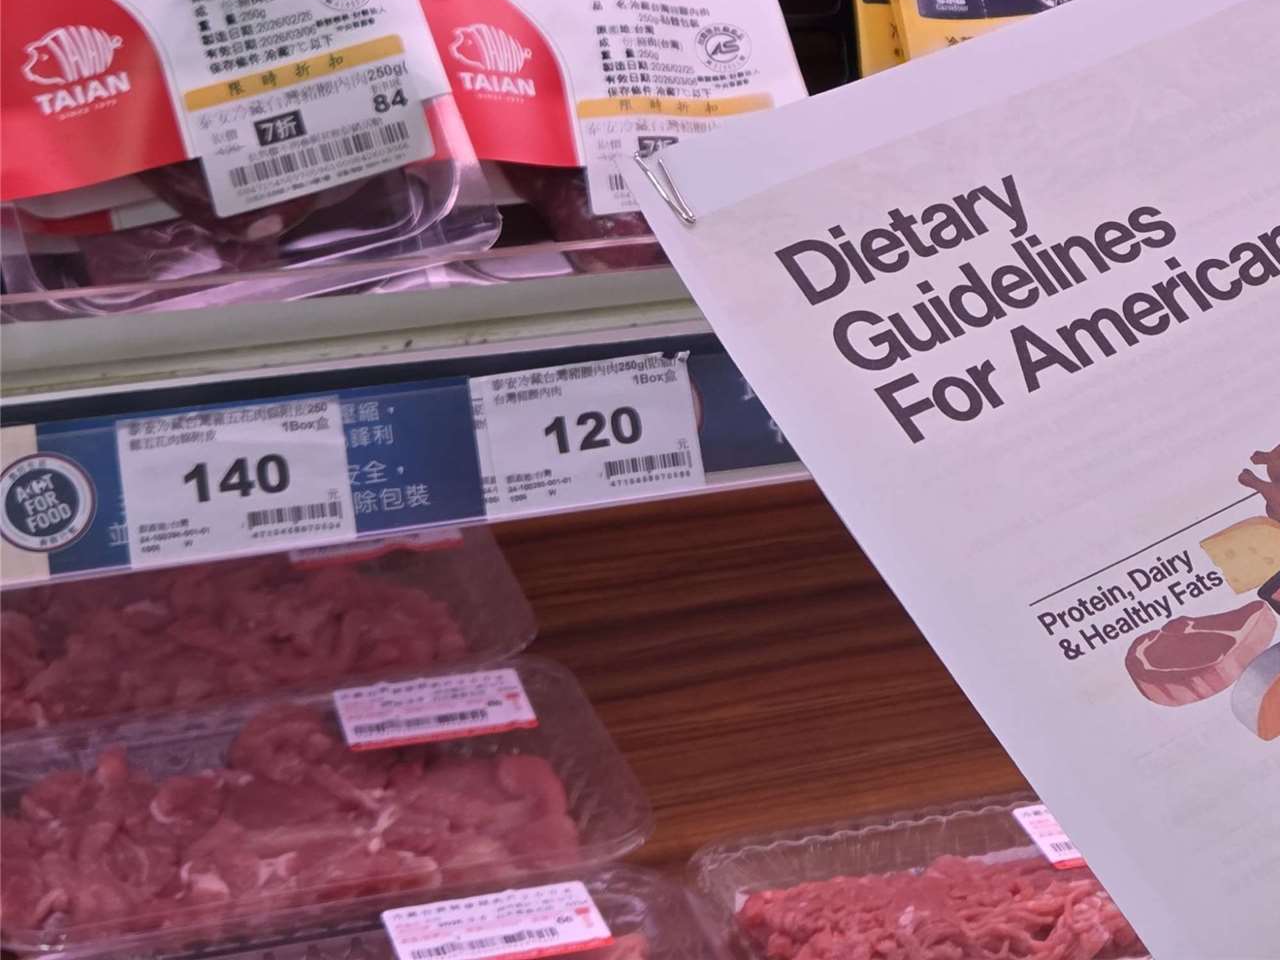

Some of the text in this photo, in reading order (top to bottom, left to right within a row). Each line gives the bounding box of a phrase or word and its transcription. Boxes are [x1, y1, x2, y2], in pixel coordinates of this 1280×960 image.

[32, 71, 131, 116] TAIAN
[372, 88, 409, 114] 84
[459, 71, 536, 98] TAIAN
[257, 115, 299, 143] 7折
[774, 173, 1030, 307] Dietary
[832, 204, 1177, 372] Guidelines
[873, 358, 1006, 445] For
[544, 405, 643, 455] 120
[183, 452, 291, 503] 140
[24, 490, 60, 516] FOR
[26, 502, 72, 533] FOOD
[1037, 549, 1195, 637] Protein, Dairy
[1058, 569, 1225, 661] & Healthy Fats
